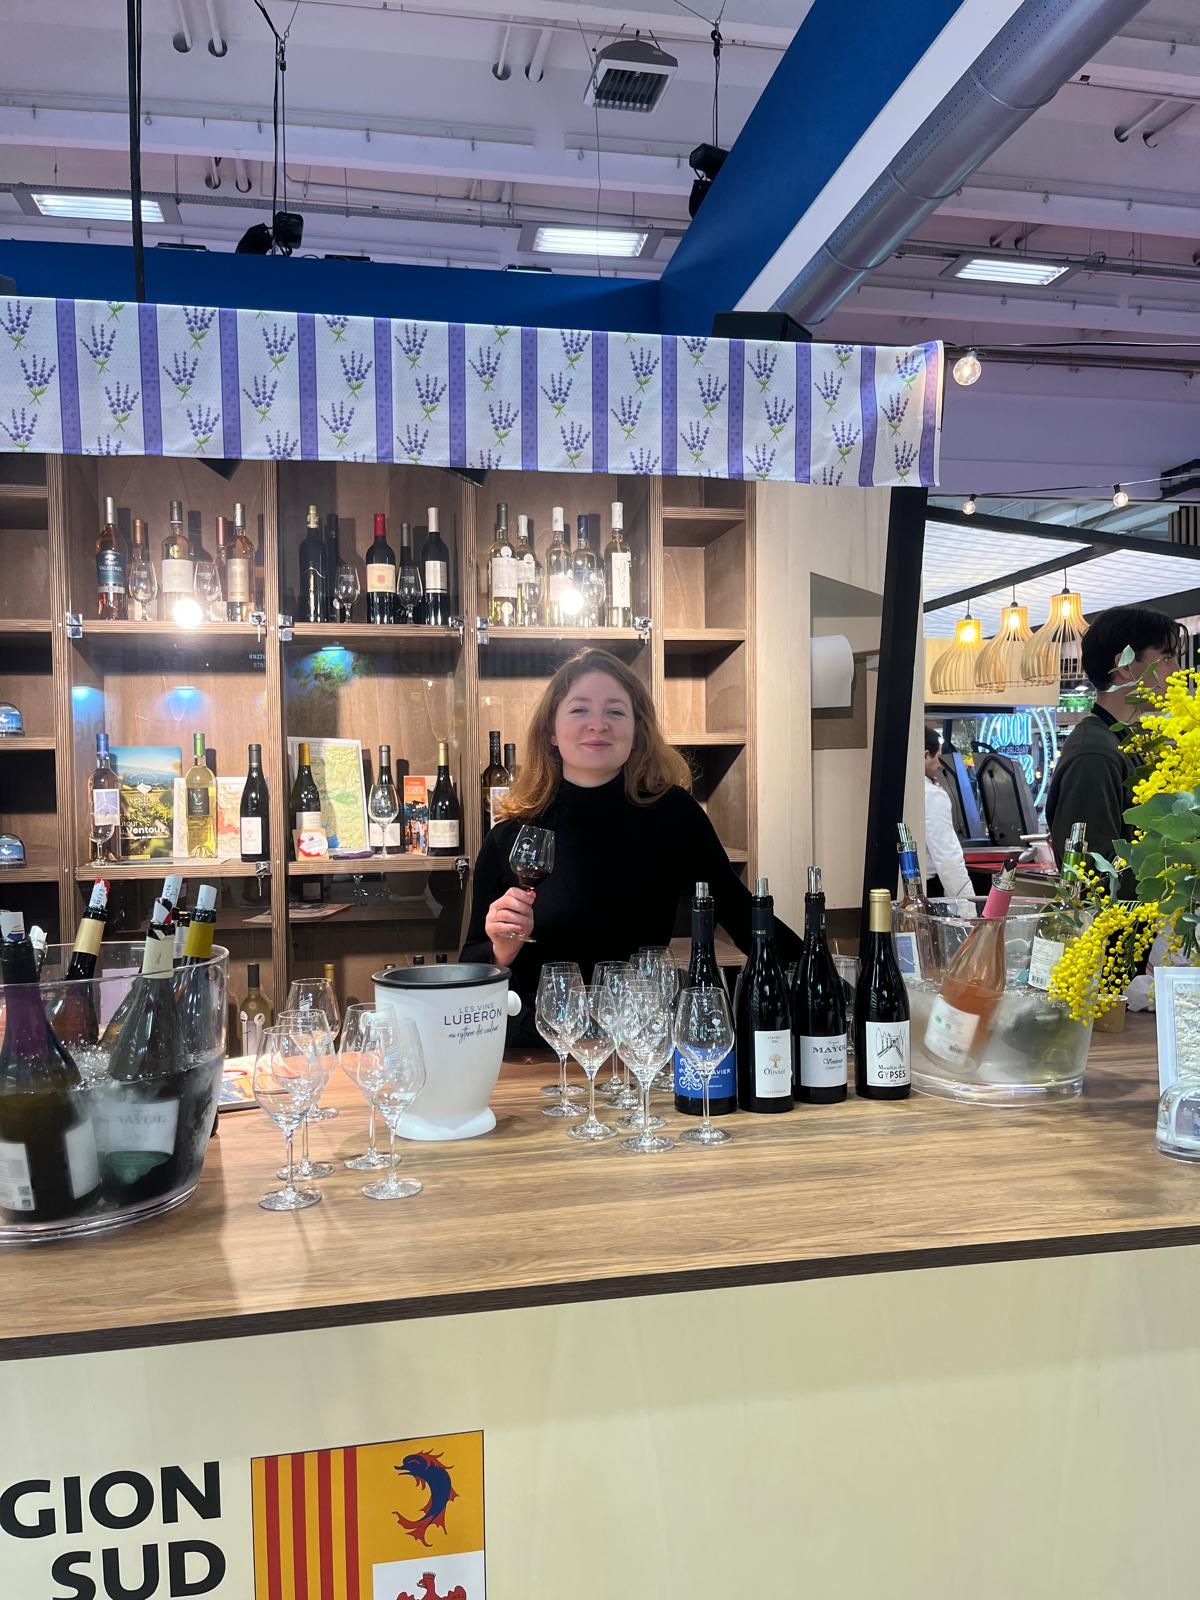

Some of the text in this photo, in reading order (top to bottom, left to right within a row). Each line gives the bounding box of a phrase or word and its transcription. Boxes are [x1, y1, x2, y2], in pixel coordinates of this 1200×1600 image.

[444, 1008, 502, 1025] LUBERON
[877, 1069, 906, 1078] GYPSES
[51, 1539, 227, 1600] SUD
